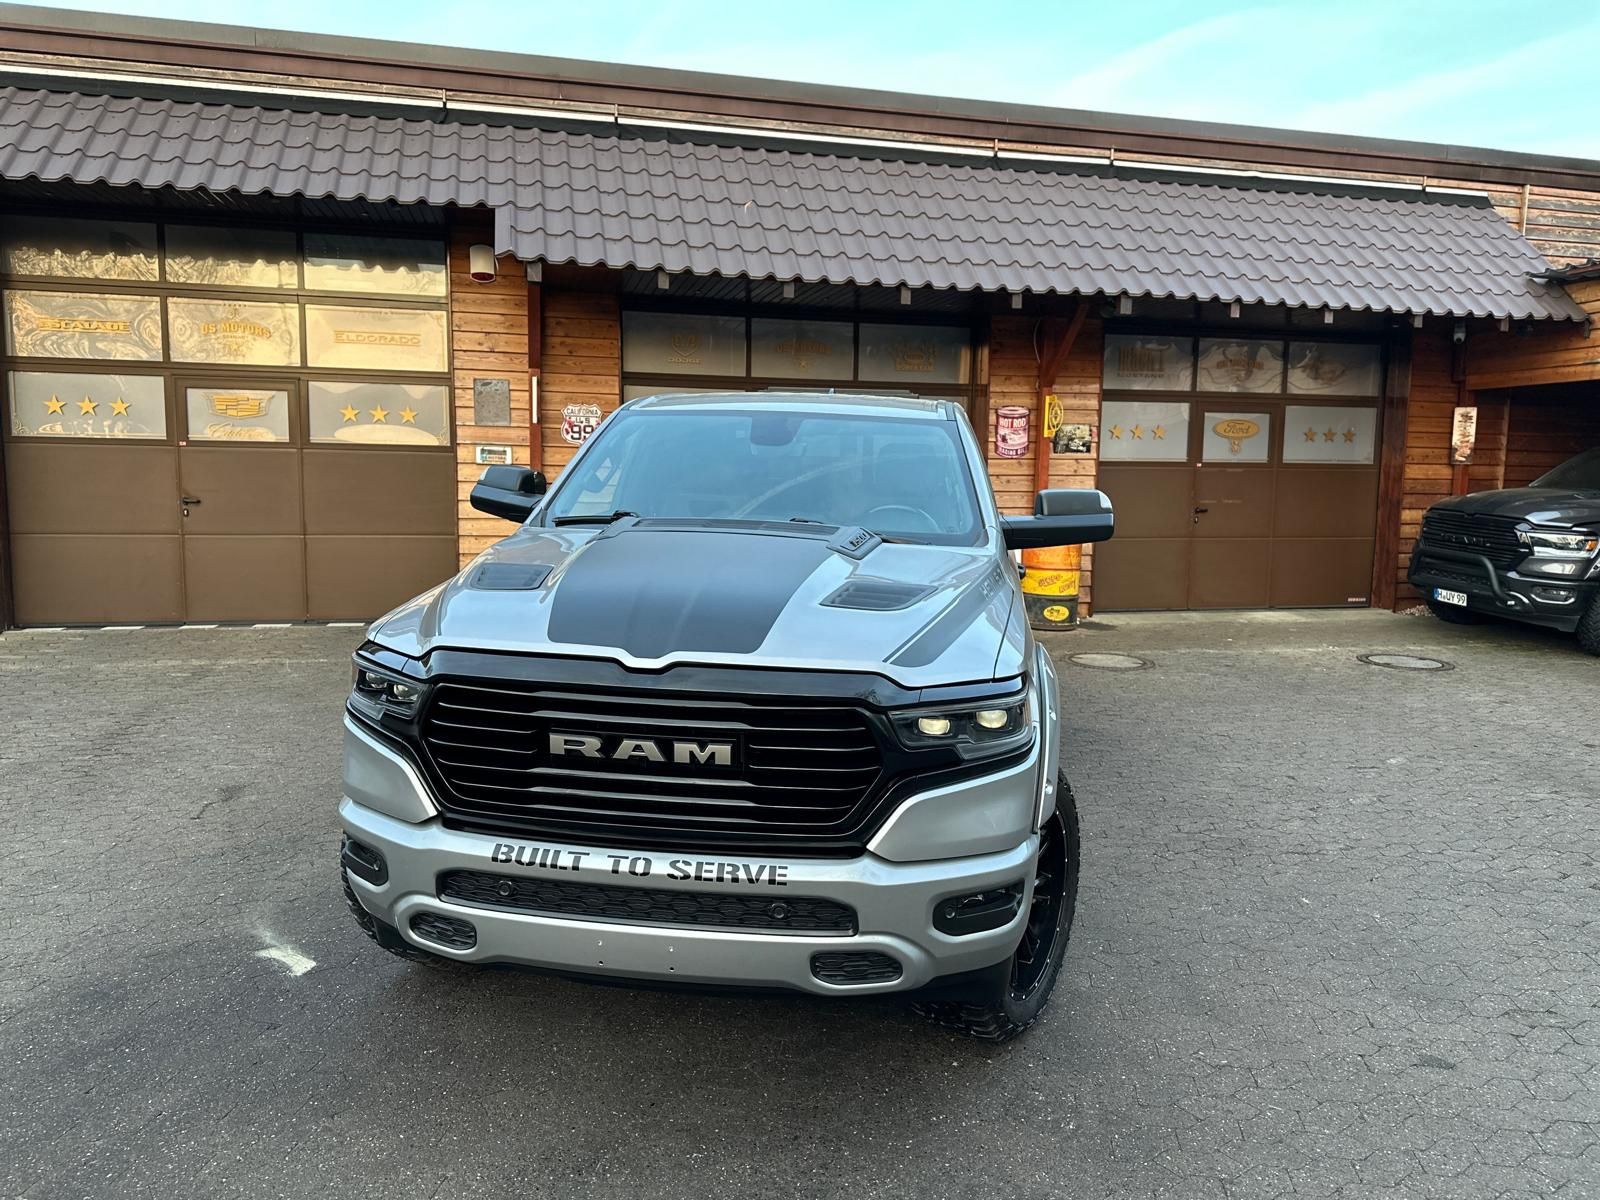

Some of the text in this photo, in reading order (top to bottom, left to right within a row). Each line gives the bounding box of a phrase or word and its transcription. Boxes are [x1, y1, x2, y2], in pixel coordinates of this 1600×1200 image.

[201, 320, 272, 339] US MOTORS
[335, 332, 421, 346] ELDORADO
[566, 407, 599, 416] CALIFORNIA
[999, 417, 1026, 428] HOT ROD
[1223, 421, 1251, 434] Ford
[1456, 593, 1466, 605] 99
[549, 732, 732, 766] RAM
[491, 843, 788, 886] BUILT TO SERVE
